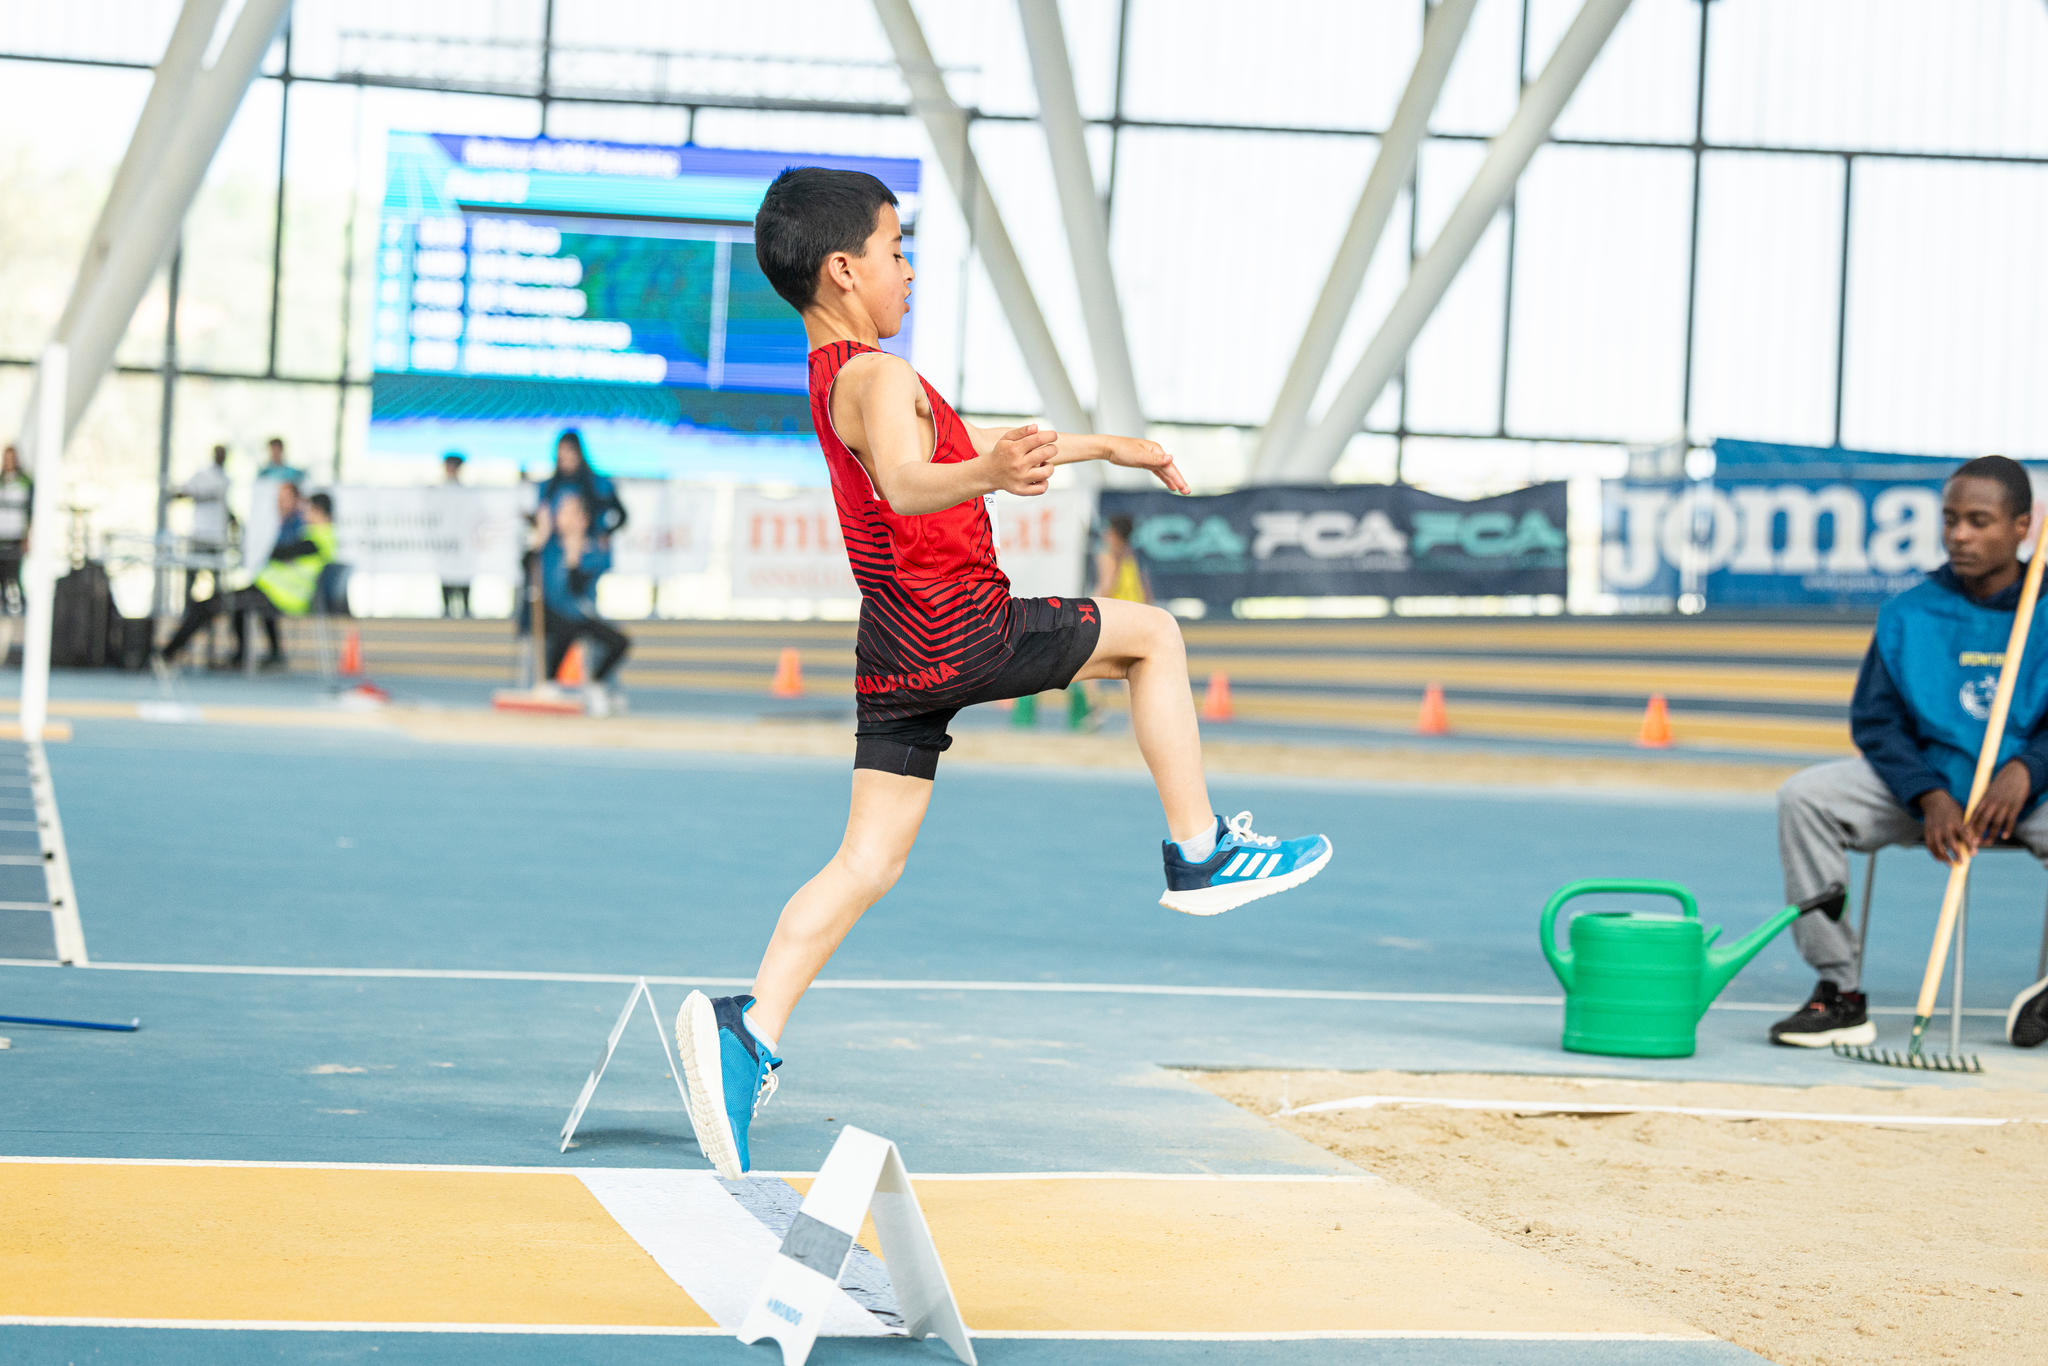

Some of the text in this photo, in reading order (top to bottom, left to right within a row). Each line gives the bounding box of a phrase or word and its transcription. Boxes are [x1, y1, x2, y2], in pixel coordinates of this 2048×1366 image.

[1132, 514, 1247, 562] CA
[1251, 510, 1409, 560] FCA
[1410, 509, 1565, 559] FCA
[854, 661, 960, 695] BADALONA
